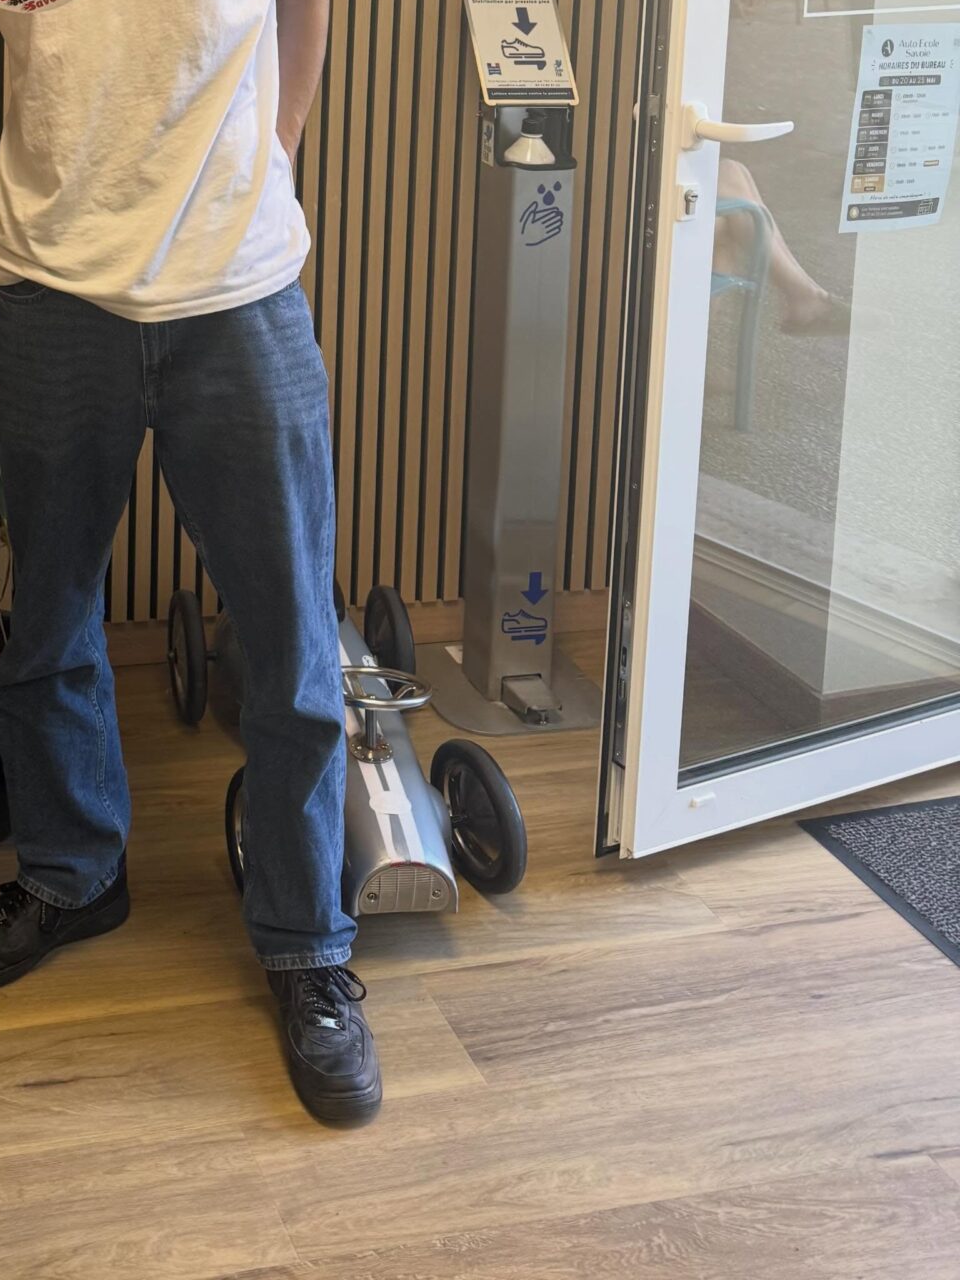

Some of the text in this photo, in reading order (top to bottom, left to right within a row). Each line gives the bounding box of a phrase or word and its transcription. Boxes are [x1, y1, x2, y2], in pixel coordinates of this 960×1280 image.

[905, 49, 930, 58] Savoie
[879, 60, 946, 70] HORAIRES DU BUREAU
